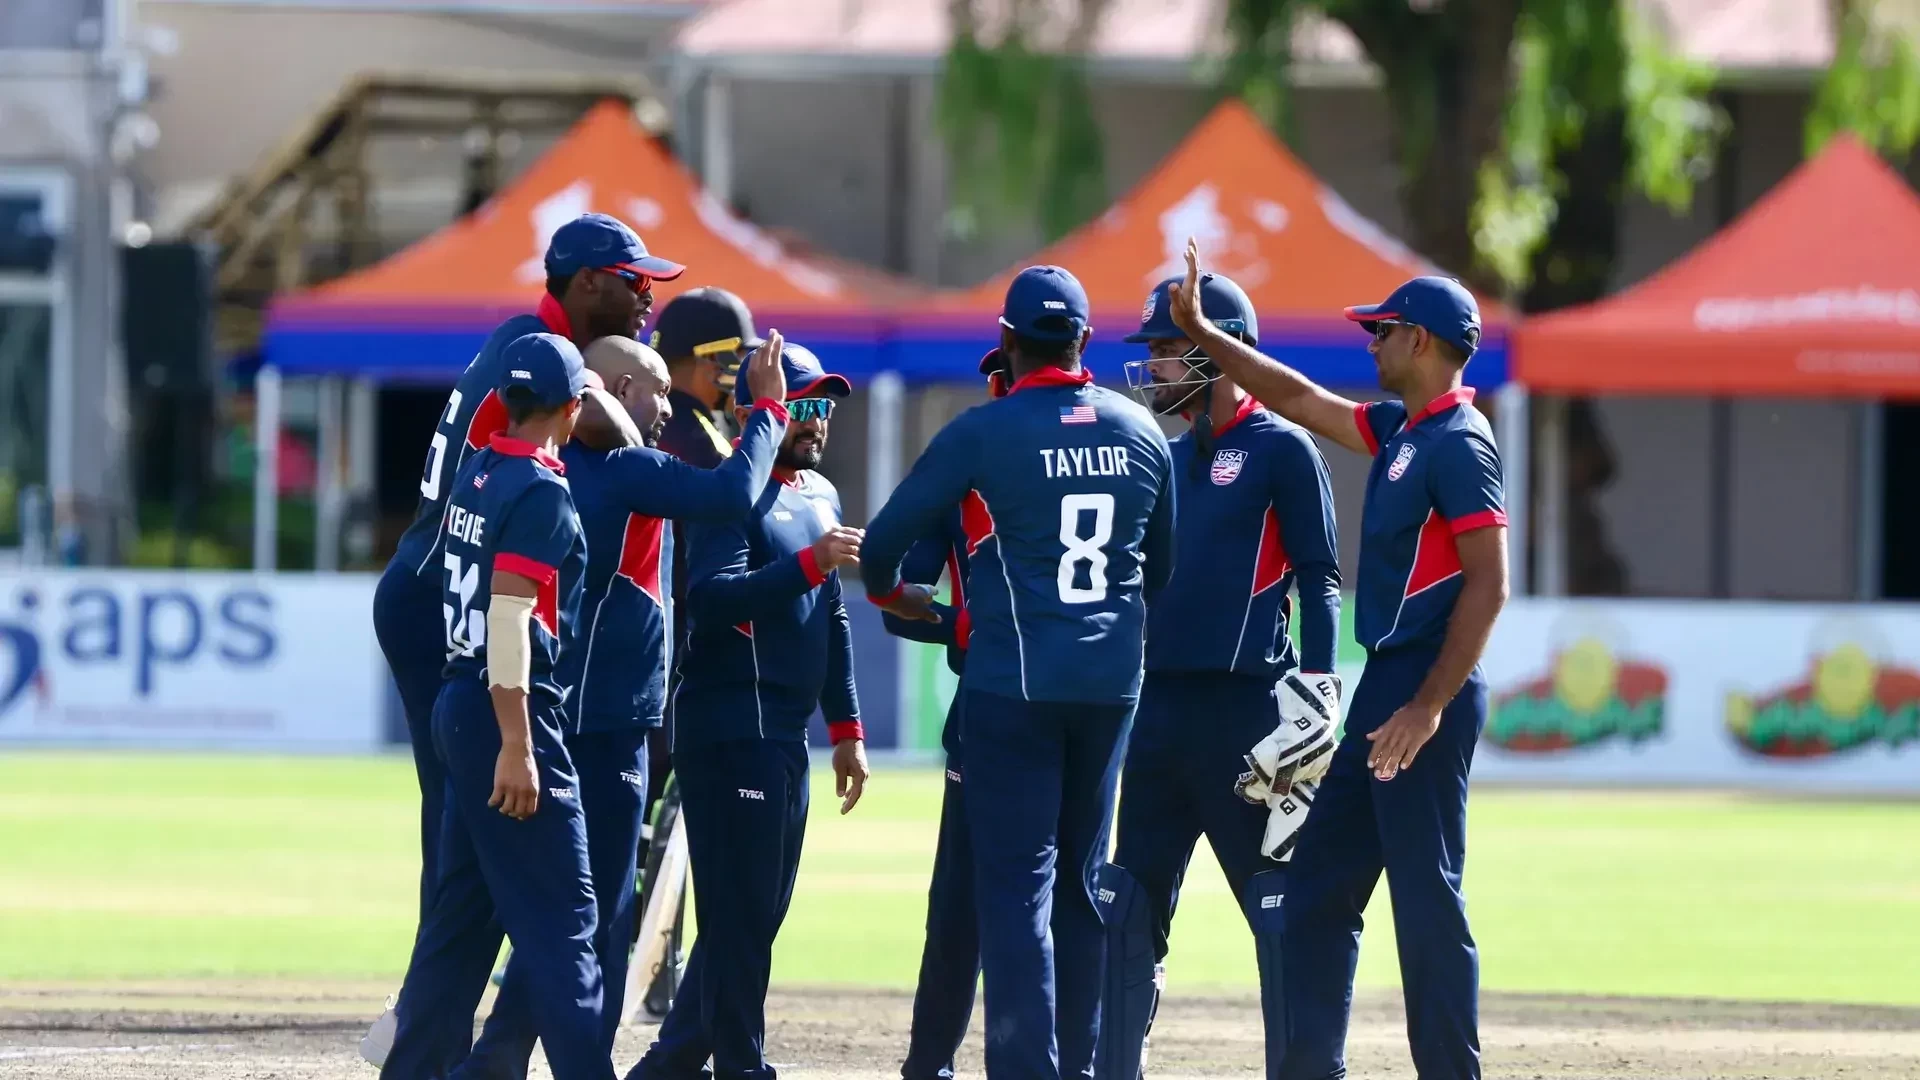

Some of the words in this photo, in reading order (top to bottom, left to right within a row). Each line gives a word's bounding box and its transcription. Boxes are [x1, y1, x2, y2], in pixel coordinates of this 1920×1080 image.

[1217, 451, 1244, 462] USA
[1399, 445, 1414, 460] USA
[1040, 446, 1130, 478] TAYLOR
[1057, 493, 1115, 604] 8
[738, 788, 764, 801] TYKA
